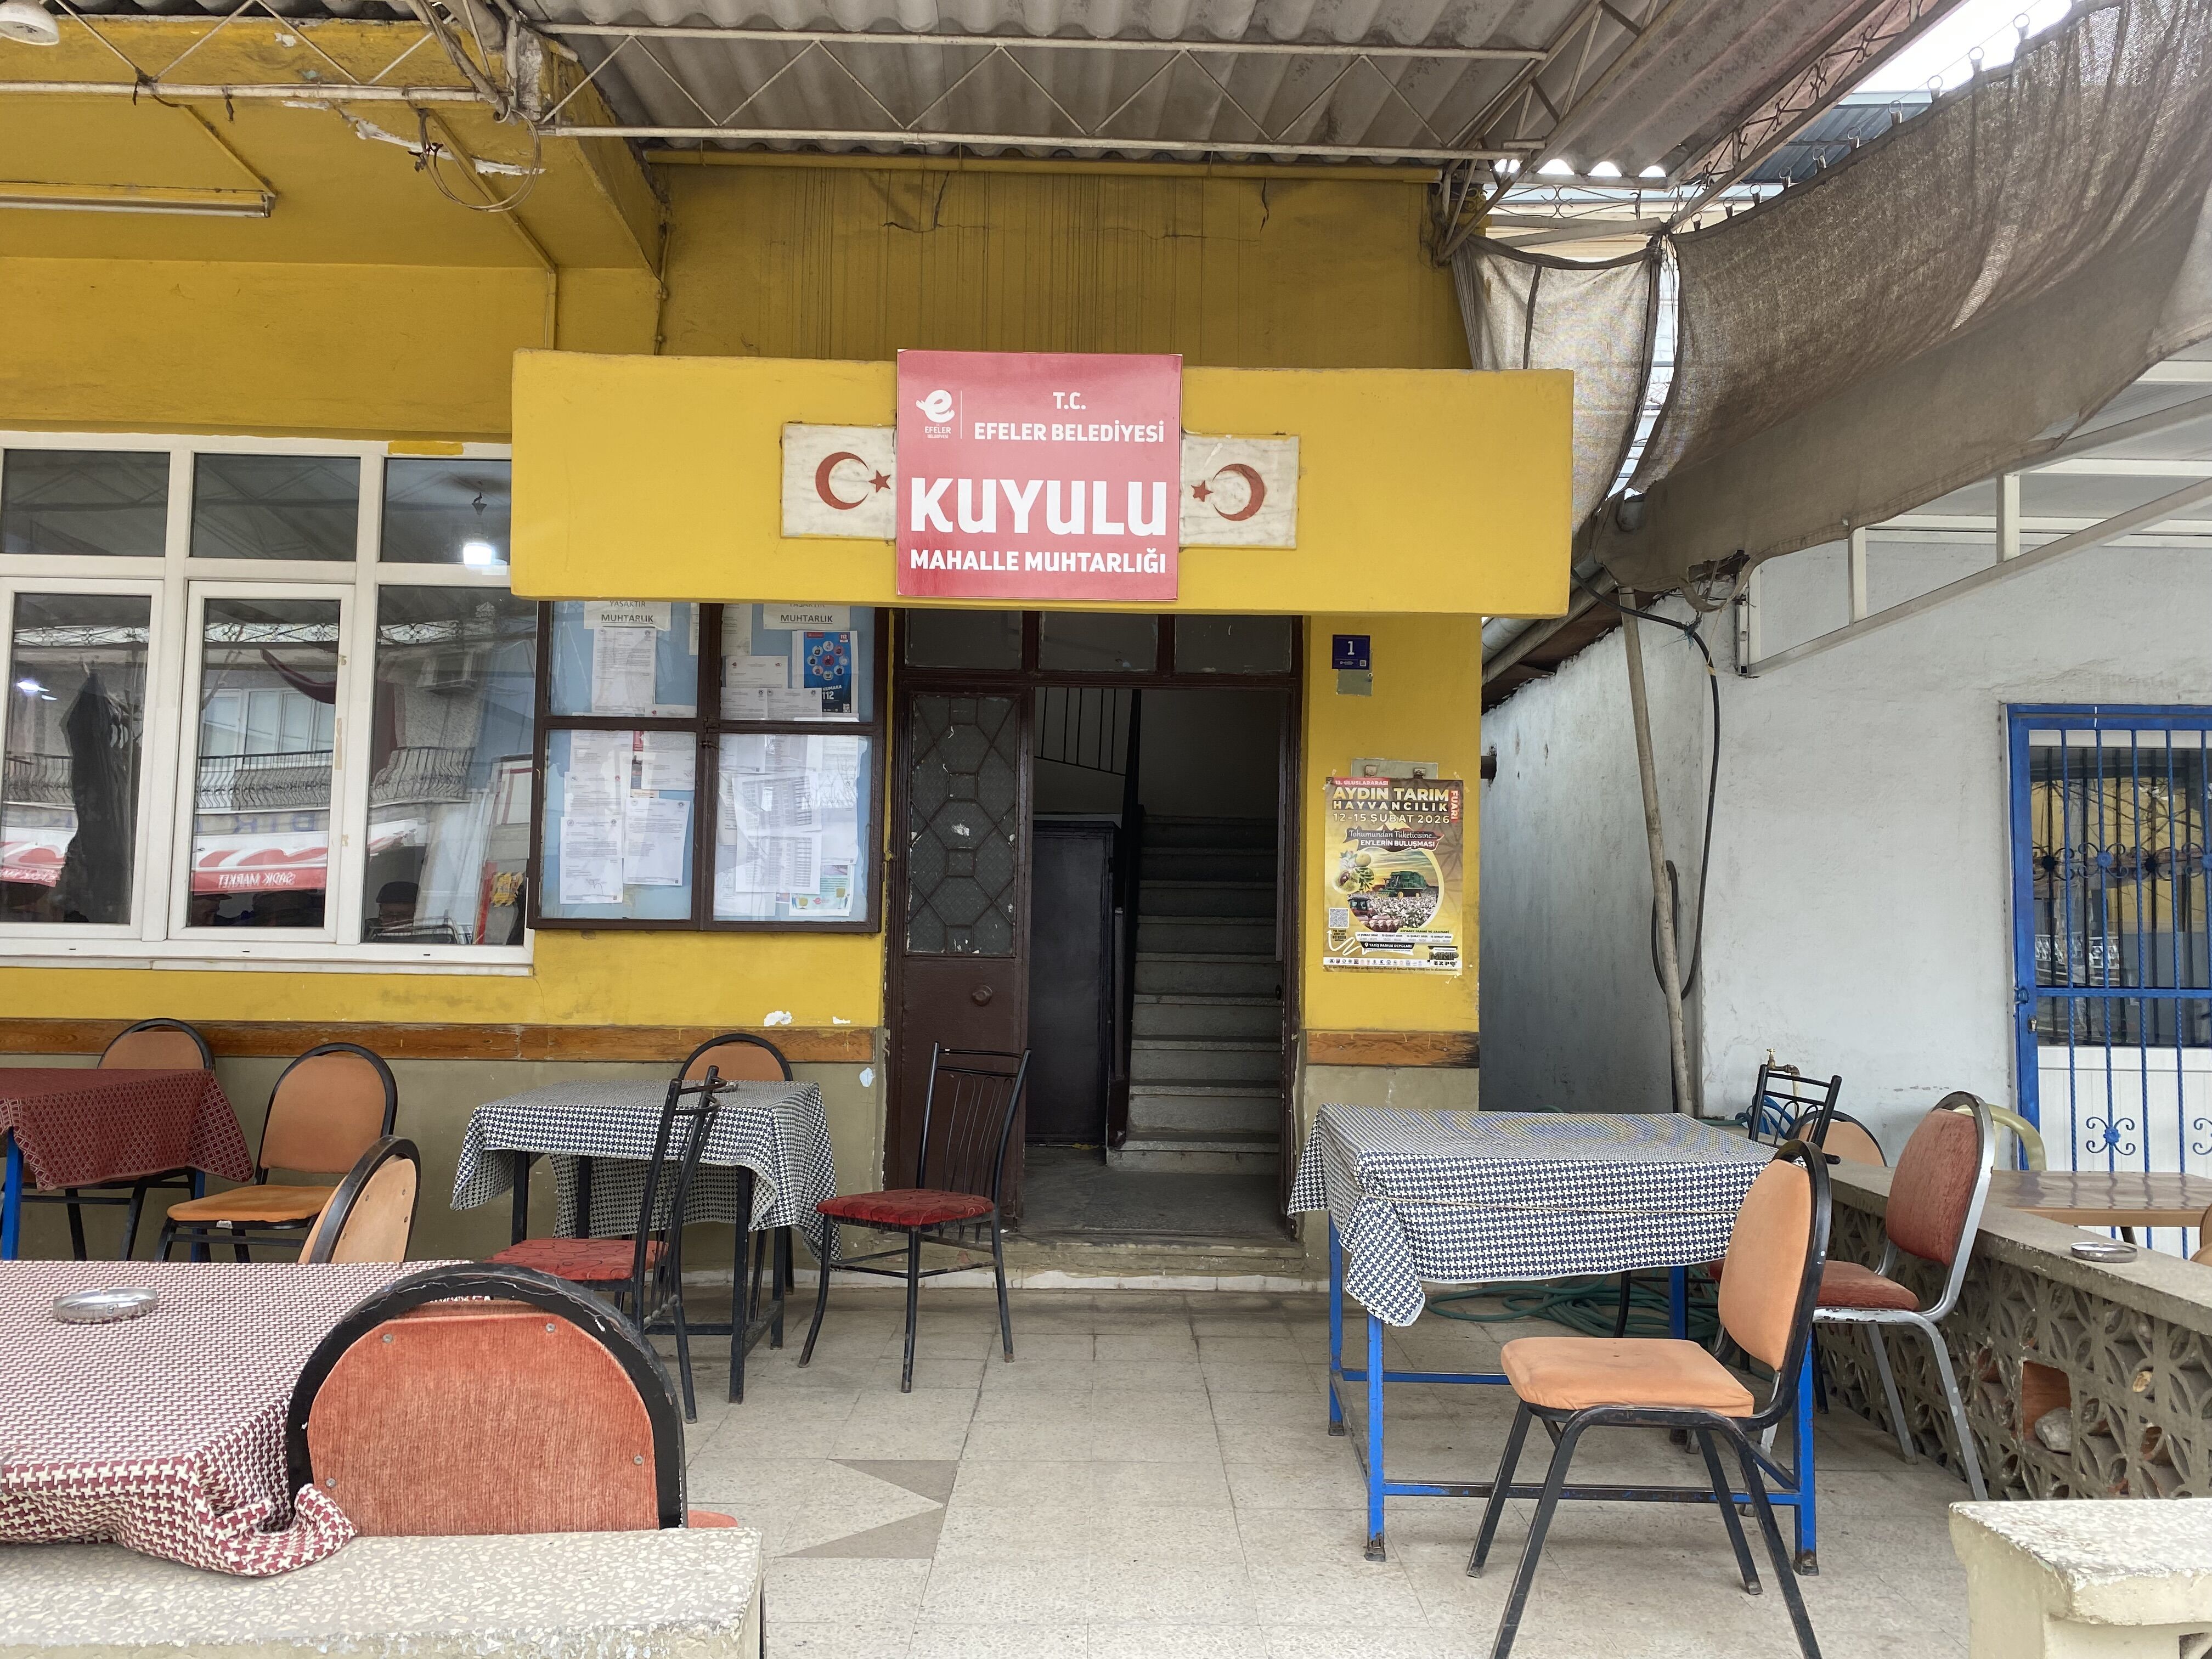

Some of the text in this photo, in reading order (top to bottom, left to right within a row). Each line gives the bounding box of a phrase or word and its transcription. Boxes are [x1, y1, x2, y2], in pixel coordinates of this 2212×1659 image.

[1053, 392, 1086, 410] T.C.
[924, 426, 951, 434] EFELER
[974, 420, 1164, 443] EFELER BELEDİYESİ
[911, 477, 1167, 537] KUYULU
[910, 548, 1165, 573] MAHALLE MUHTARLIĞI
[601, 614, 653, 623] MUHTARLIK
[781, 614, 833, 623] MUHTARLIK
[1347, 641, 1355, 656] 1
[822, 691, 834, 699] 112
[1333, 787, 1449, 802] AYDIN TARIM
[1333, 800, 1448, 812] HAYVANCILIK
[1333, 813, 1450, 824] 12-15 ŞUBAT 2026
[1349, 830, 1393, 838] Tohumundan
[1394, 840, 1435, 848] BULUŞMASI
